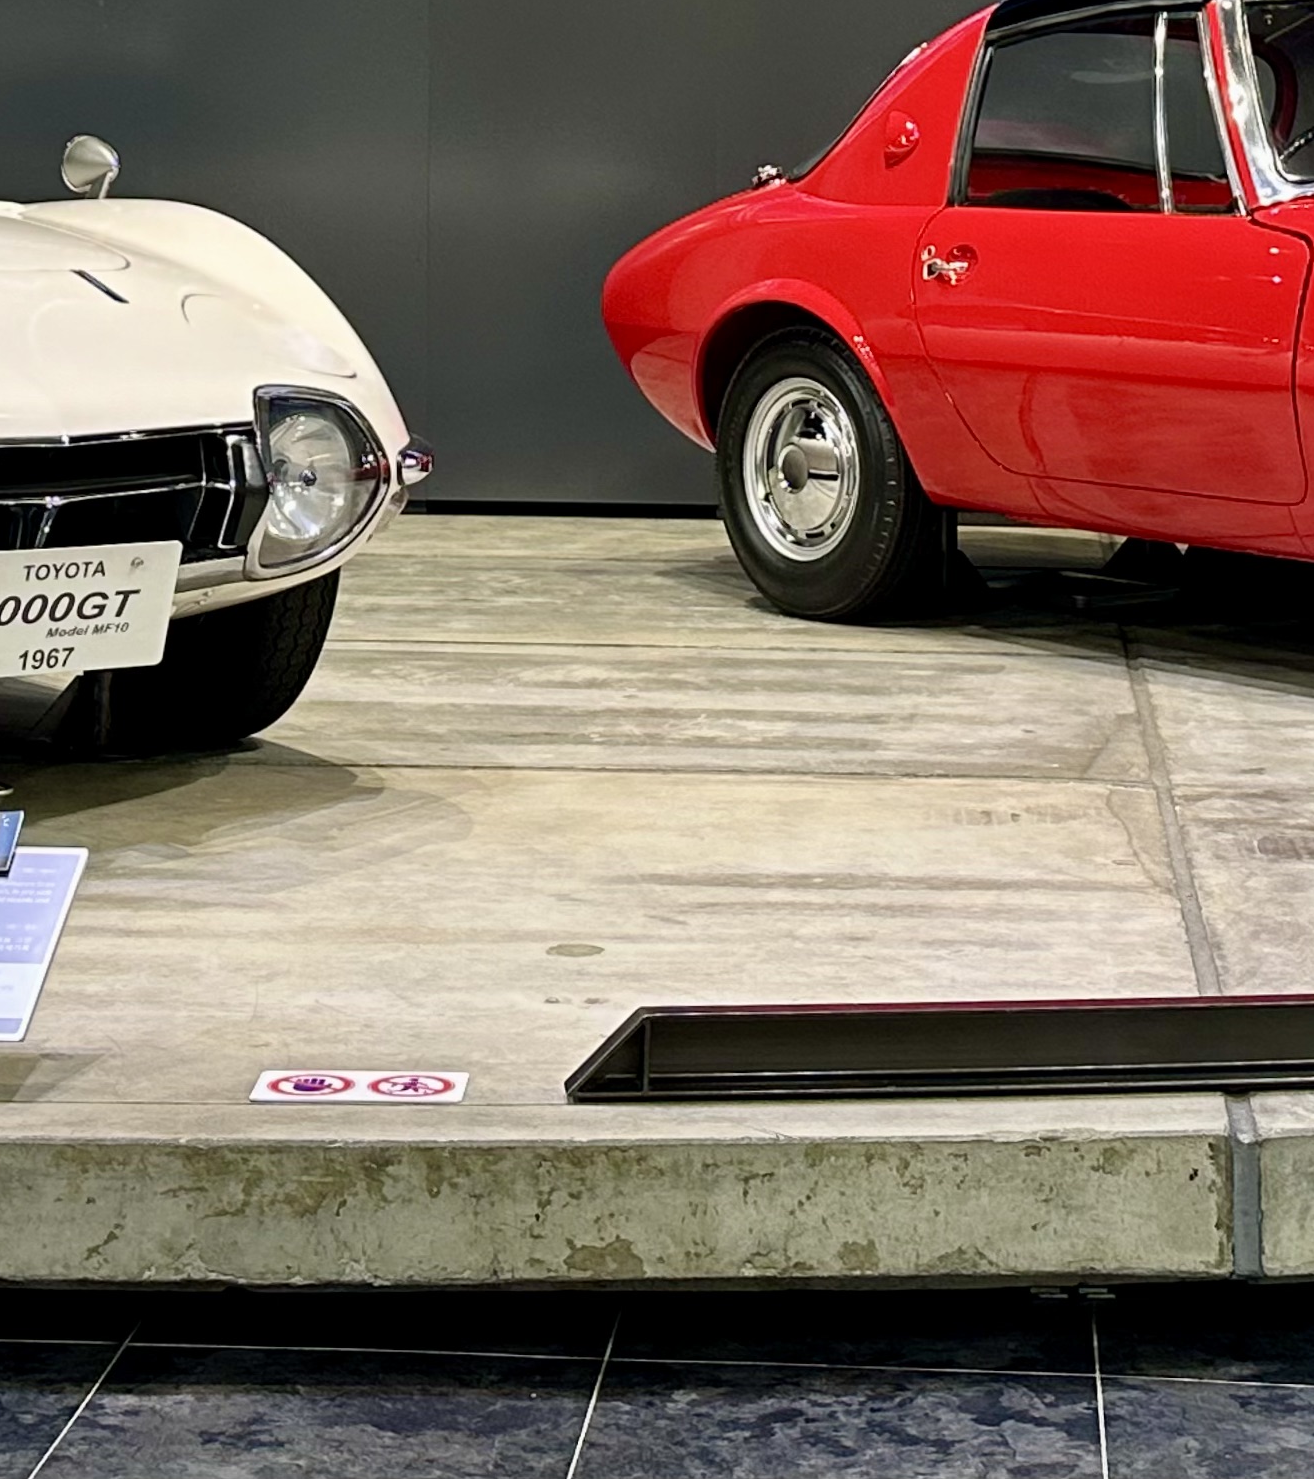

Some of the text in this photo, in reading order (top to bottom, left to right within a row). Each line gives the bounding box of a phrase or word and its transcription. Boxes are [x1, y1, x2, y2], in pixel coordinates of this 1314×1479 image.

[23, 561, 106, 582] TOYOTA
[45, 622, 130, 638] Model MF10
[18, 647, 74, 671] 1967
